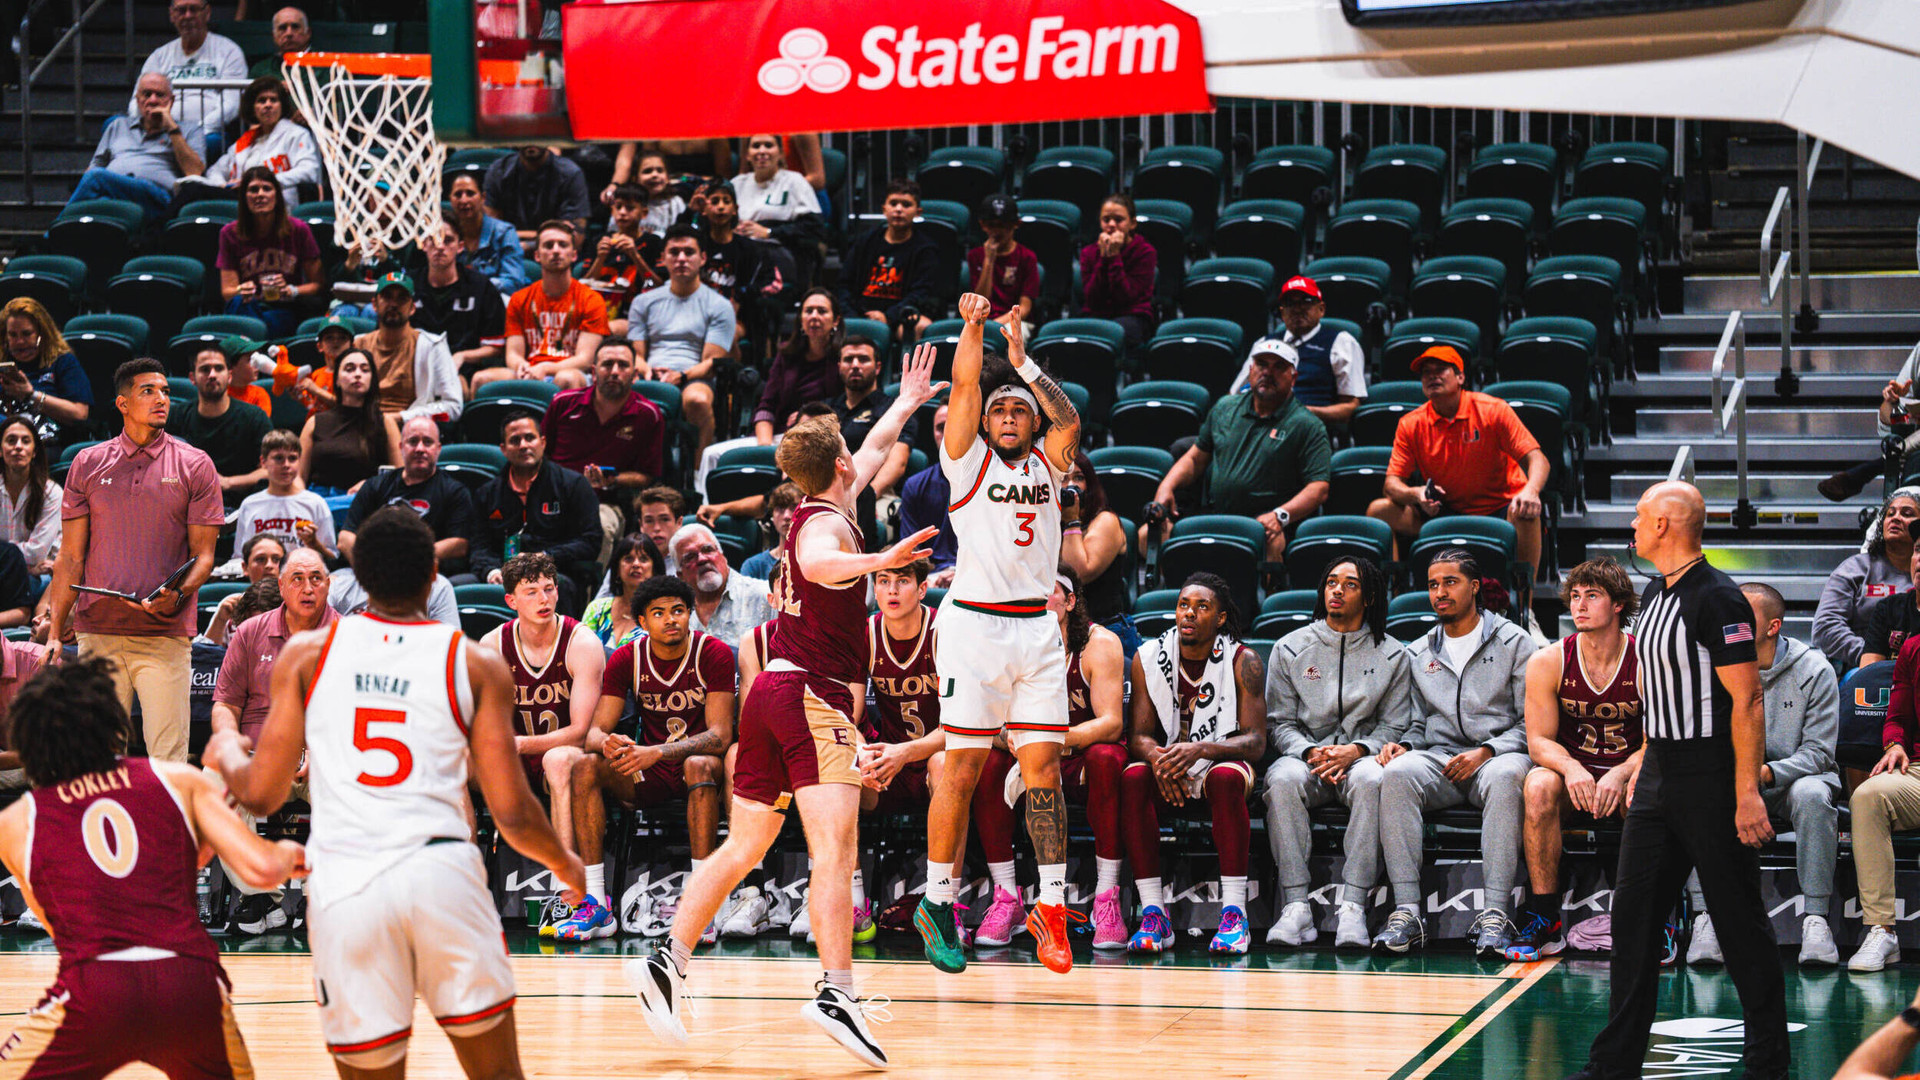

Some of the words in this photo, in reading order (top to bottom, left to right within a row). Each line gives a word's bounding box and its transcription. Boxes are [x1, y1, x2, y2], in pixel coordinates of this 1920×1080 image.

[987, 483, 1050, 505] CANES
[1013, 512, 1037, 547] 3
[639, 687, 706, 712] ELON
[871, 673, 938, 698] ELON
[900, 701, 925, 740] 5
[1561, 697, 1639, 719] ELON
[353, 707, 413, 788] 5
[832, 727, 850, 746] E
[1577, 723, 1628, 755] 25
[57, 767, 132, 804] COKLEY
[82, 798, 139, 878] 0
